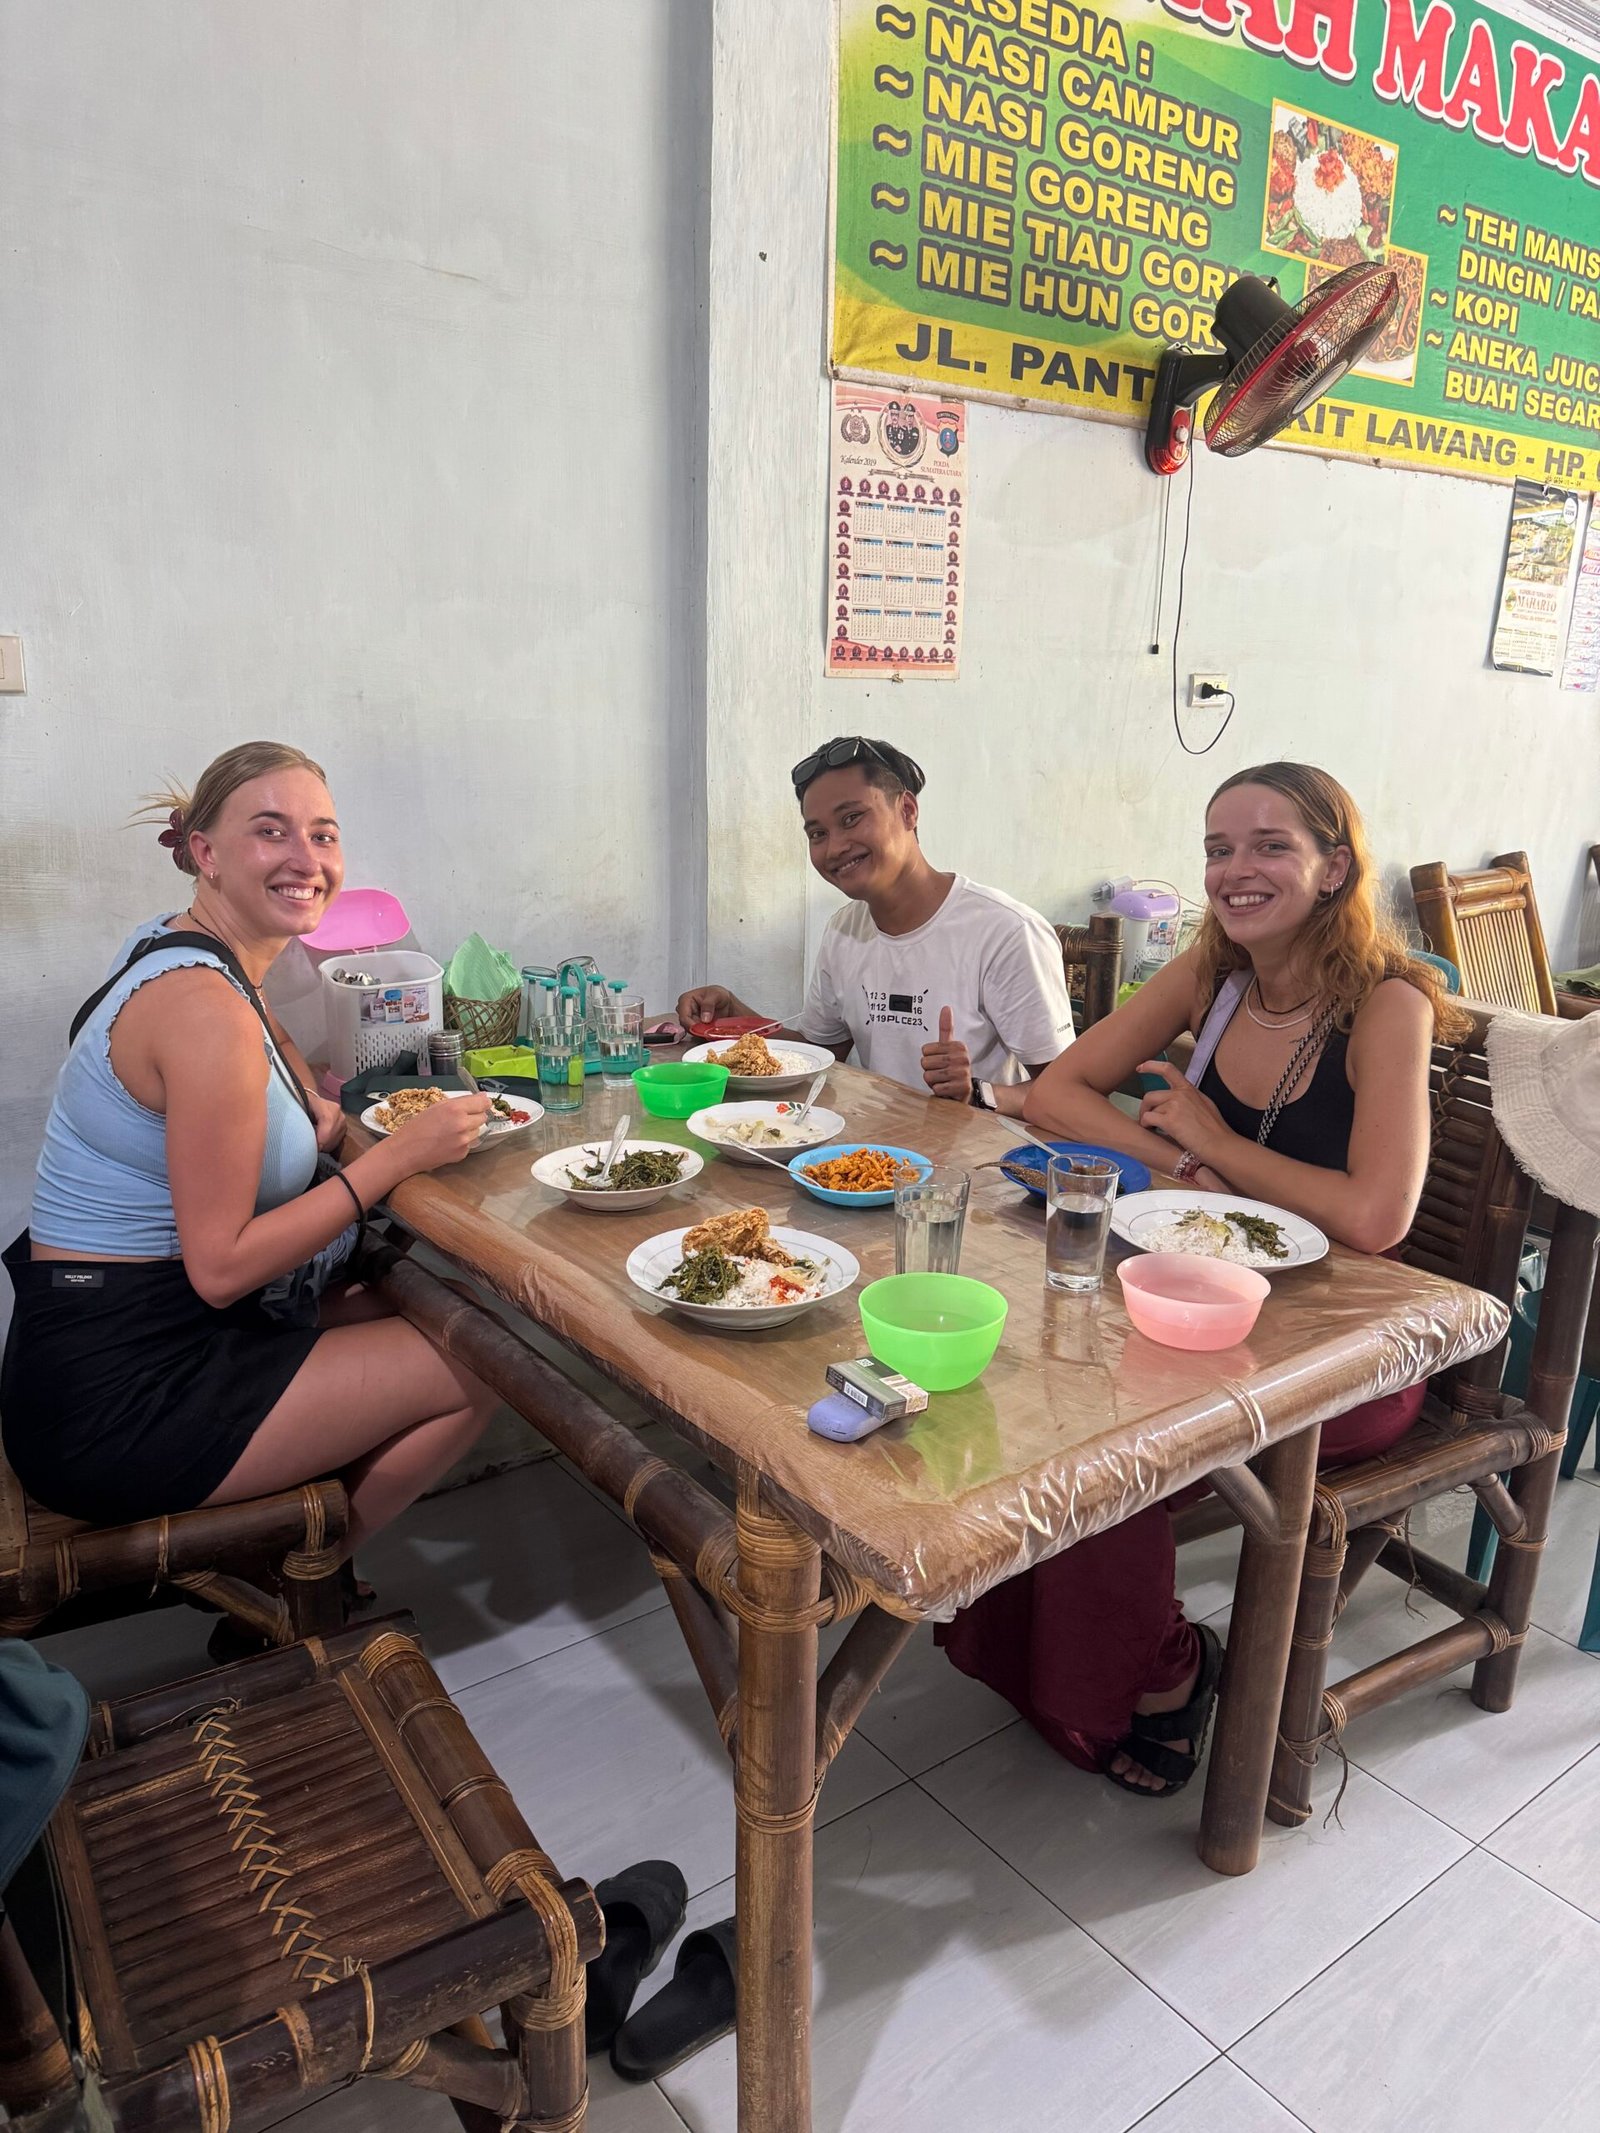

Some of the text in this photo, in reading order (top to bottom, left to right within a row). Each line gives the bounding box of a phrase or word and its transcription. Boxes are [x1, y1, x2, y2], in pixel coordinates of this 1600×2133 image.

[929, 15, 1240, 161] NASI CAMPUR
[928, 74, 1235, 206] NASI GORENG
[925, 132, 1209, 247] MIE GORENG
[923, 189, 1012, 247] MIE
[1026, 217, 1130, 276] TIAU
[1464, 207, 1600, 280] TEH MANIS
[921, 246, 1011, 300] MIE
[1024, 272, 1120, 324] HUN
[1454, 290, 1518, 333] KOPI
[1459, 250, 1552, 304] DINGIN
[1569, 285, 1600, 320] PA
[895, 323, 987, 374] JL.
[1449, 331, 1600, 394] ANEKA JUIC
[1445, 370, 1600, 430] BUAH SEGAR
[1366, 413, 1517, 466] LAWANG
[1544, 447, 1586, 479] HP.
